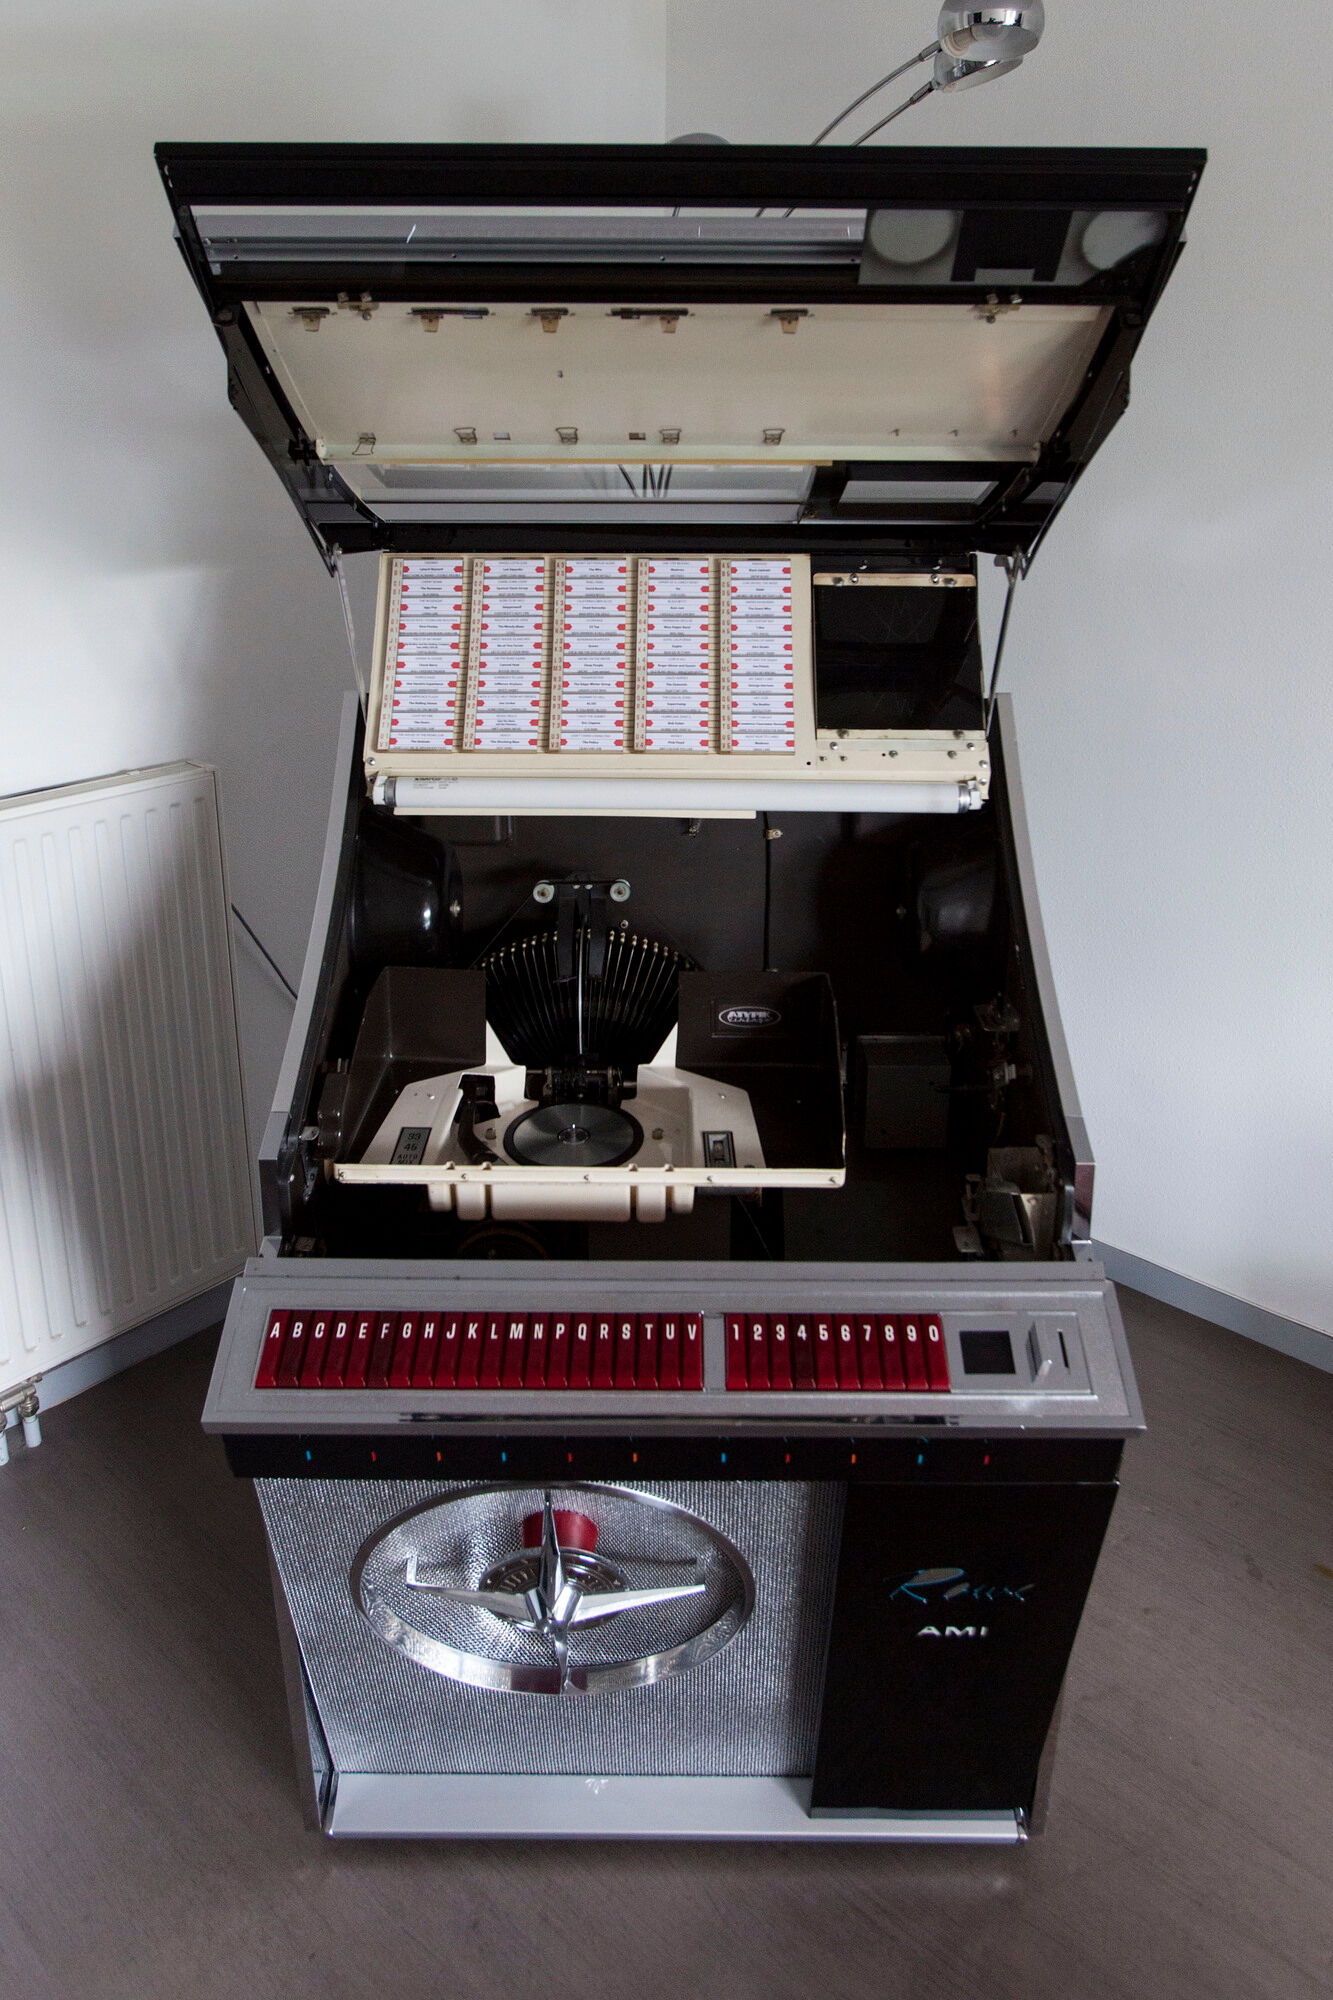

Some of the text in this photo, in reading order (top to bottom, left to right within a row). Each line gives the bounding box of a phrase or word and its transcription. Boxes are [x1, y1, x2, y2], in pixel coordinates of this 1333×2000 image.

[269, 1321, 697, 1341] A B C D E F G H J K L M N P Q R S T U V
[732, 1323, 940, 1342] 1 2 3 4 5 6 7 8 9 0
[914, 1625, 990, 1639] AMI
